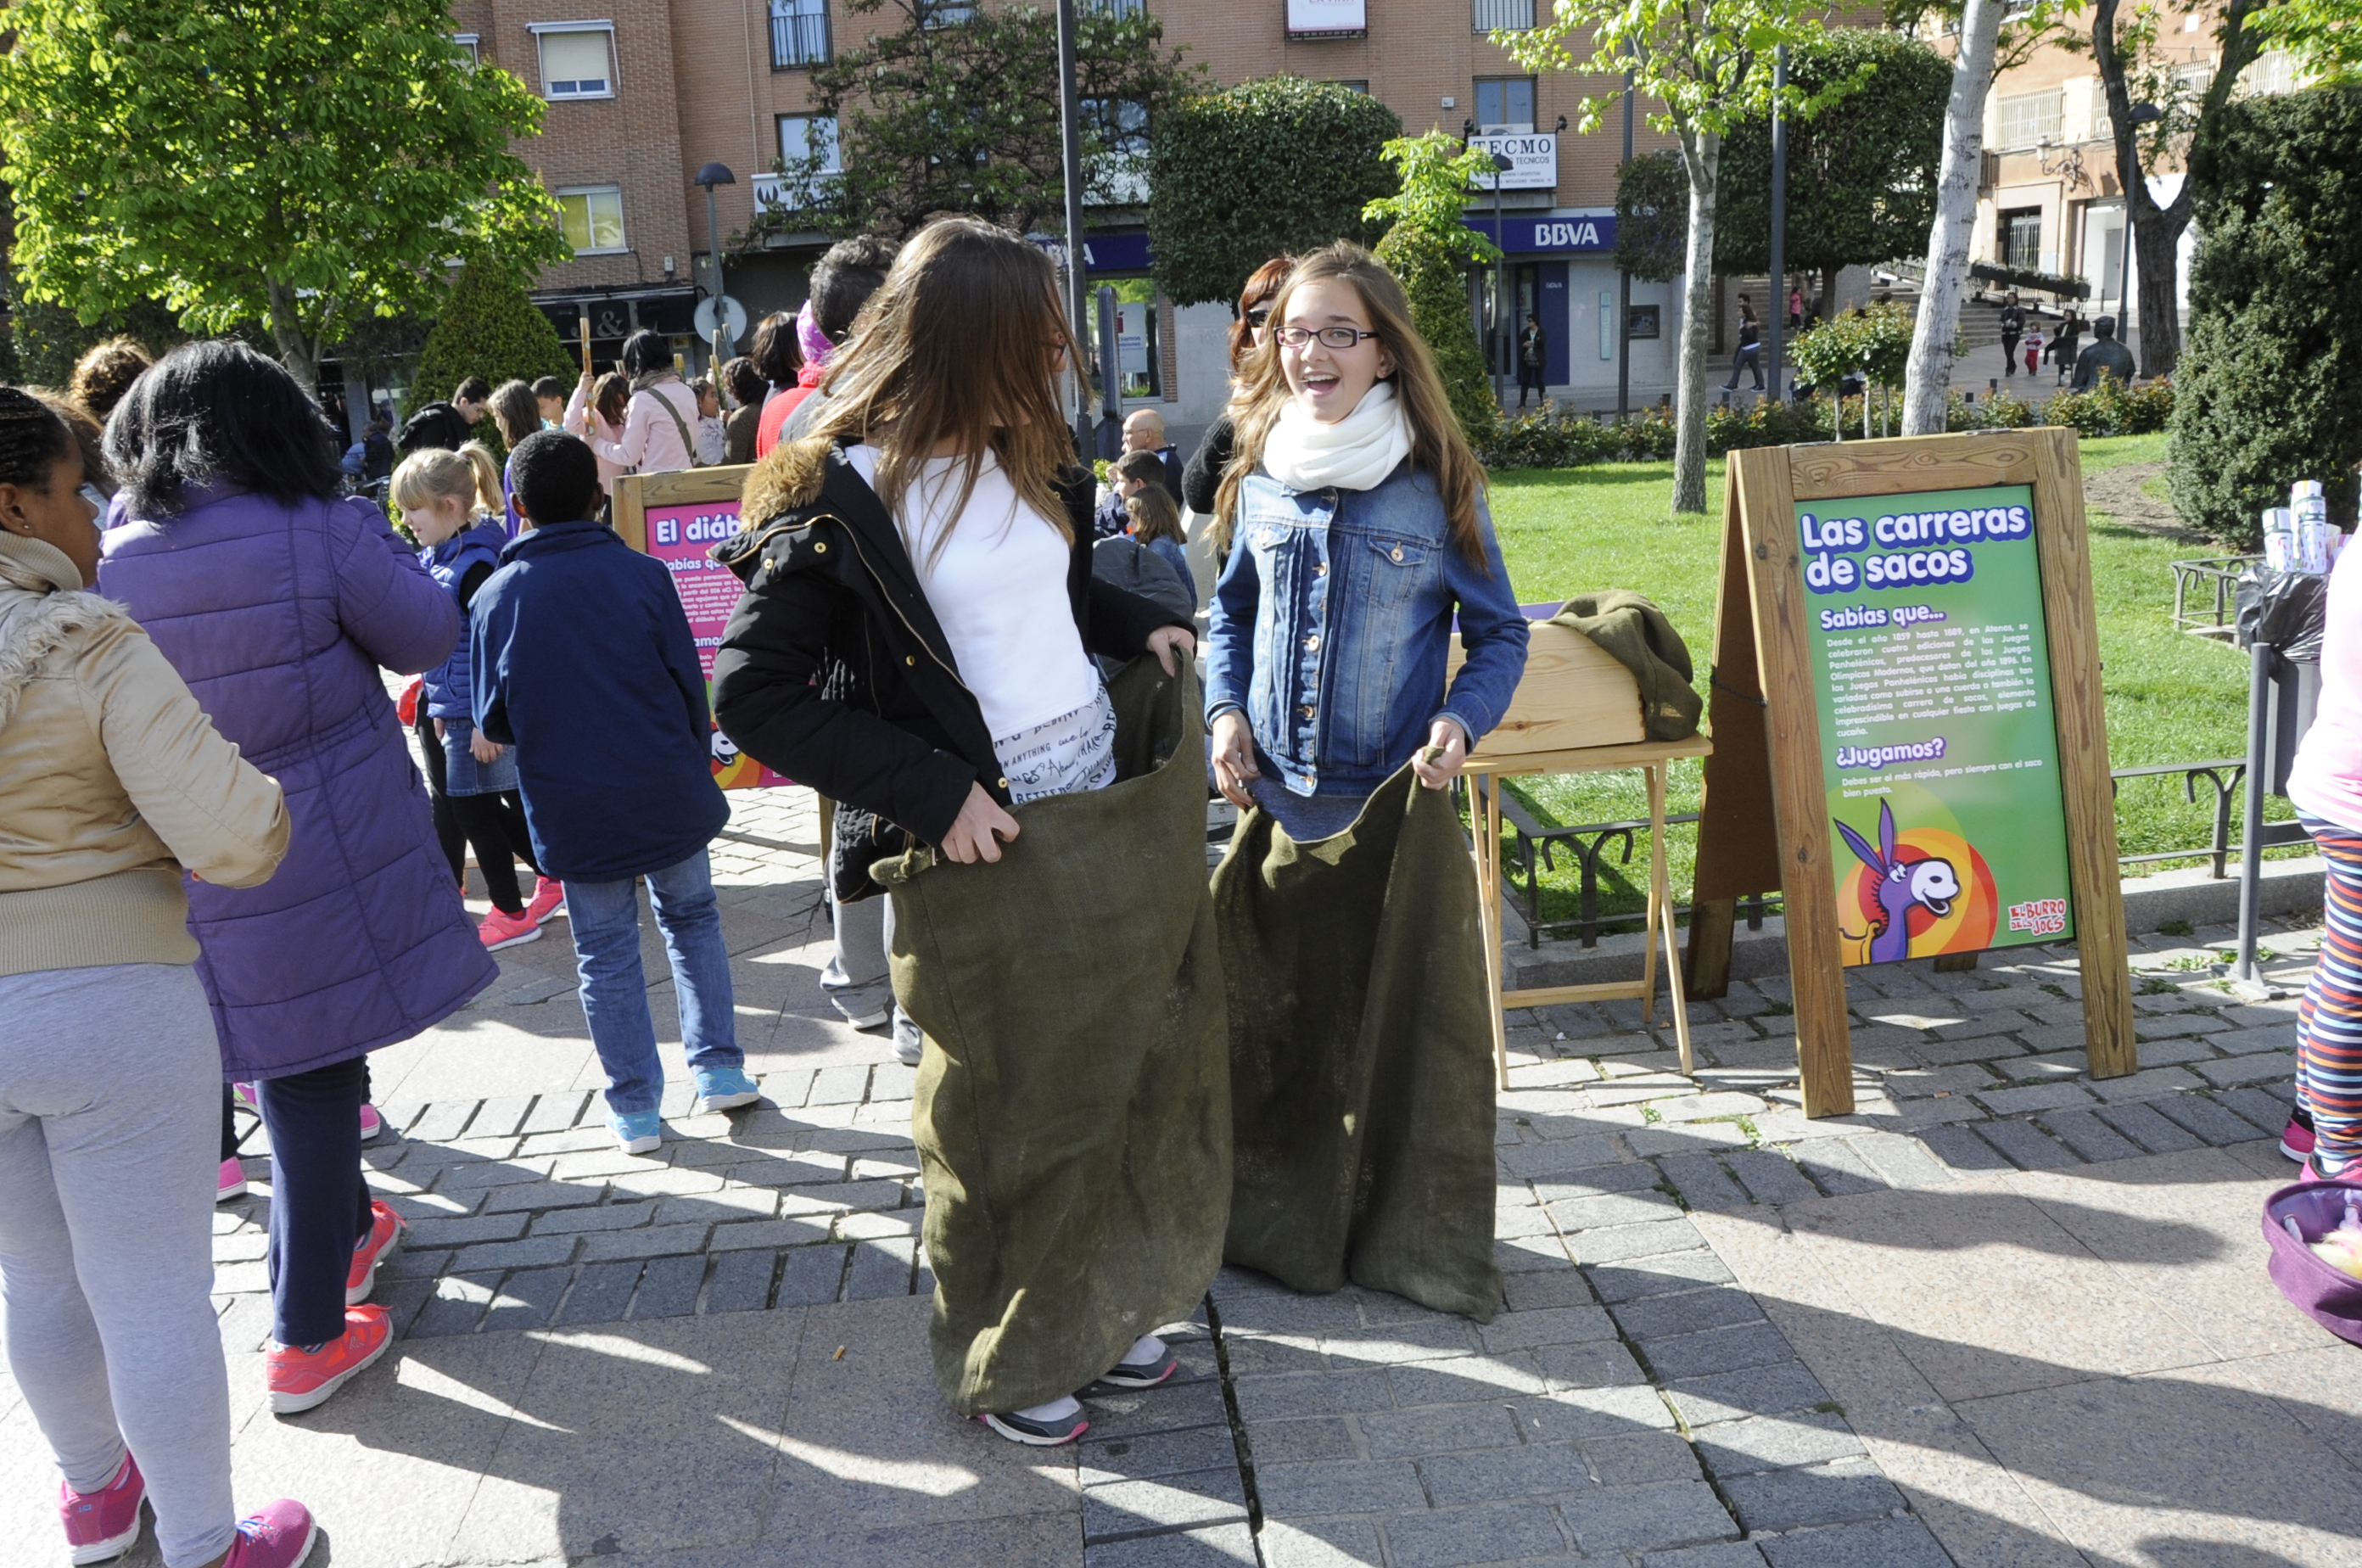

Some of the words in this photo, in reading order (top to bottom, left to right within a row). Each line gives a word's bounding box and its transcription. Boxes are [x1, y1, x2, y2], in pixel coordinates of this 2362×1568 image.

[1473, 138, 1551, 154] TECMO
[1515, 156, 1549, 165] TECNICOS
[1535, 223, 1599, 246] BBVA
[657, 518, 677, 543] El
[686, 513, 741, 540] diáb
[1801, 515, 1864, 548] Las
[1876, 506, 2026, 542] carreras
[666, 557, 702, 571] abías
[1806, 552, 1855, 587] de
[1866, 549, 1968, 583] sacos
[1820, 605, 1887, 630] Sabías
[1892, 606, 1945, 627] que...
[1827, 636, 1853, 647] Desde
[1858, 636, 1867, 645] el
[1871, 635, 1888, 643] año
[1892, 631, 1911, 641] 1859
[1916, 630, 1939, 639] hasta
[1828, 647, 1873, 658] celebraron
[1882, 644, 1909, 653] cuatro
[1917, 641, 1956, 650] ediciones
[1963, 638, 1974, 647] de
[2001, 634, 2030, 644] Juegos
[1896, 652, 1951, 664] predecesores
[1961, 649, 1972, 658] de
[1981, 647, 1994, 656] los
[2002, 646, 2031, 655] Juegos
[1918, 665, 1934, 674] que
[1938, 662, 1962, 671] datan
[1965, 659, 1978, 669] del
[1981, 658, 1996, 667] año
[2022, 655, 2032, 664] En
[1831, 684, 1844, 692] los
[1850, 681, 1878, 692] Juegos
[1833, 693, 1868, 703] variadas
[1870, 692, 1893, 700] como
[1934, 686, 1951, 694] una
[1953, 682, 1981, 692] cuerda
[2025, 676, 2035, 685] la
[1903, 699, 1934, 708] carrera
[1943, 696, 1955, 704] de
[1997, 688, 2035, 699] elemento
[1898, 712, 1909, 720] en
[1996, 702, 2023, 712] juegos
[2025, 699, 2037, 708] de
[1012, 742, 1051, 765] ANYTHING
[1836, 736, 1944, 768] ¿Jugamos?
[1842, 777, 1867, 787] Debes
[1869, 776, 1883, 784] ser
[1884, 773, 1893, 781] el
[1895, 771, 1912, 781] más
[1913, 769, 1943, 780] rápido,
[1944, 767, 1963, 778] pero
[1965, 764, 1997, 775] siempre
[1998, 762, 2013, 770] con
[2014, 759, 2023, 768] el
[2024, 759, 2043, 768] saco
[1843, 789, 1861, 798] bien
[1863, 786, 1893, 798] puesto.
[2011, 905, 2025, 917] EL
[2026, 900, 2065, 919] BURRO
[2034, 916, 2063, 934] JOCS
